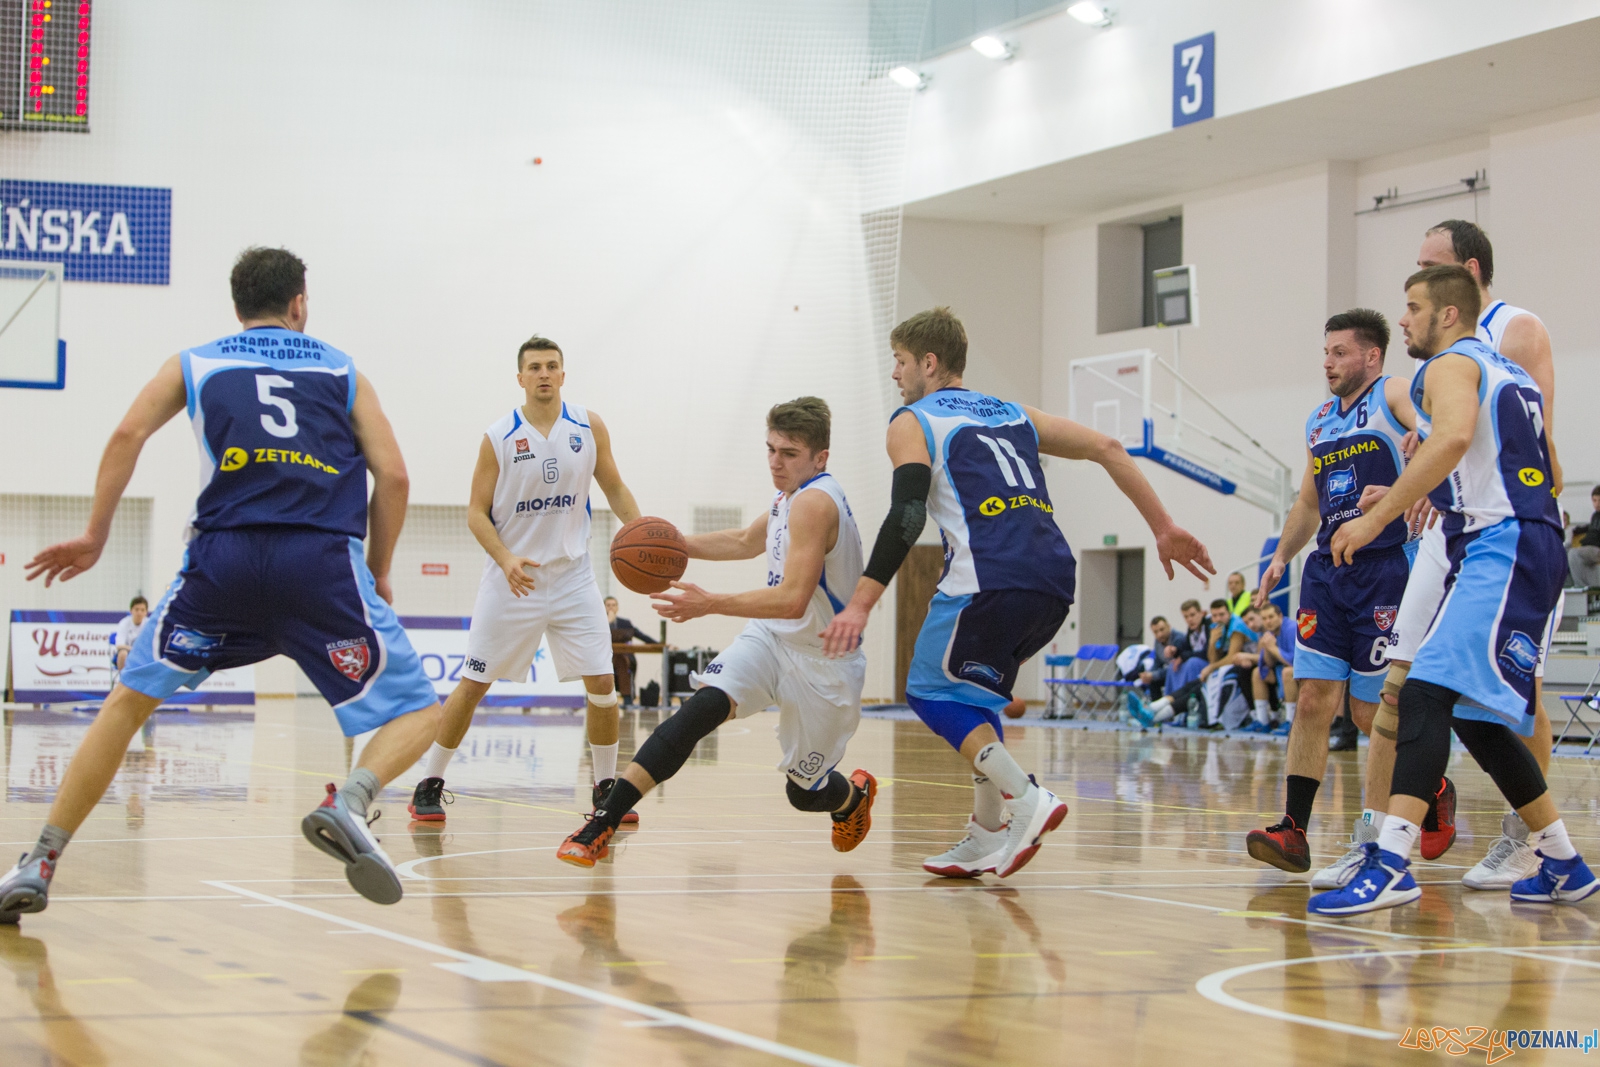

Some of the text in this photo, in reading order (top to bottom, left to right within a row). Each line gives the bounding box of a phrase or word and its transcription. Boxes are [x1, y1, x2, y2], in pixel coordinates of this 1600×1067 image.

[1180, 44, 1203, 116] 3
[0, 199, 135, 256] ŃSKA
[222, 345, 321, 361] NYSA KŁODZKO
[255, 374, 299, 438] 5
[1356, 401, 1368, 429] 6
[254, 448, 340, 475] ZETKAMA
[976, 434, 1037, 490] 11
[1322, 440, 1380, 467] ZETKAMA
[543, 458, 559, 484] 6
[325, 636, 368, 650] KŁODZKO
[1369, 635, 1389, 666] 6
[1388, 631, 1399, 646] BG
[469, 657, 487, 673] PBG
[798, 751, 825, 776] 3
